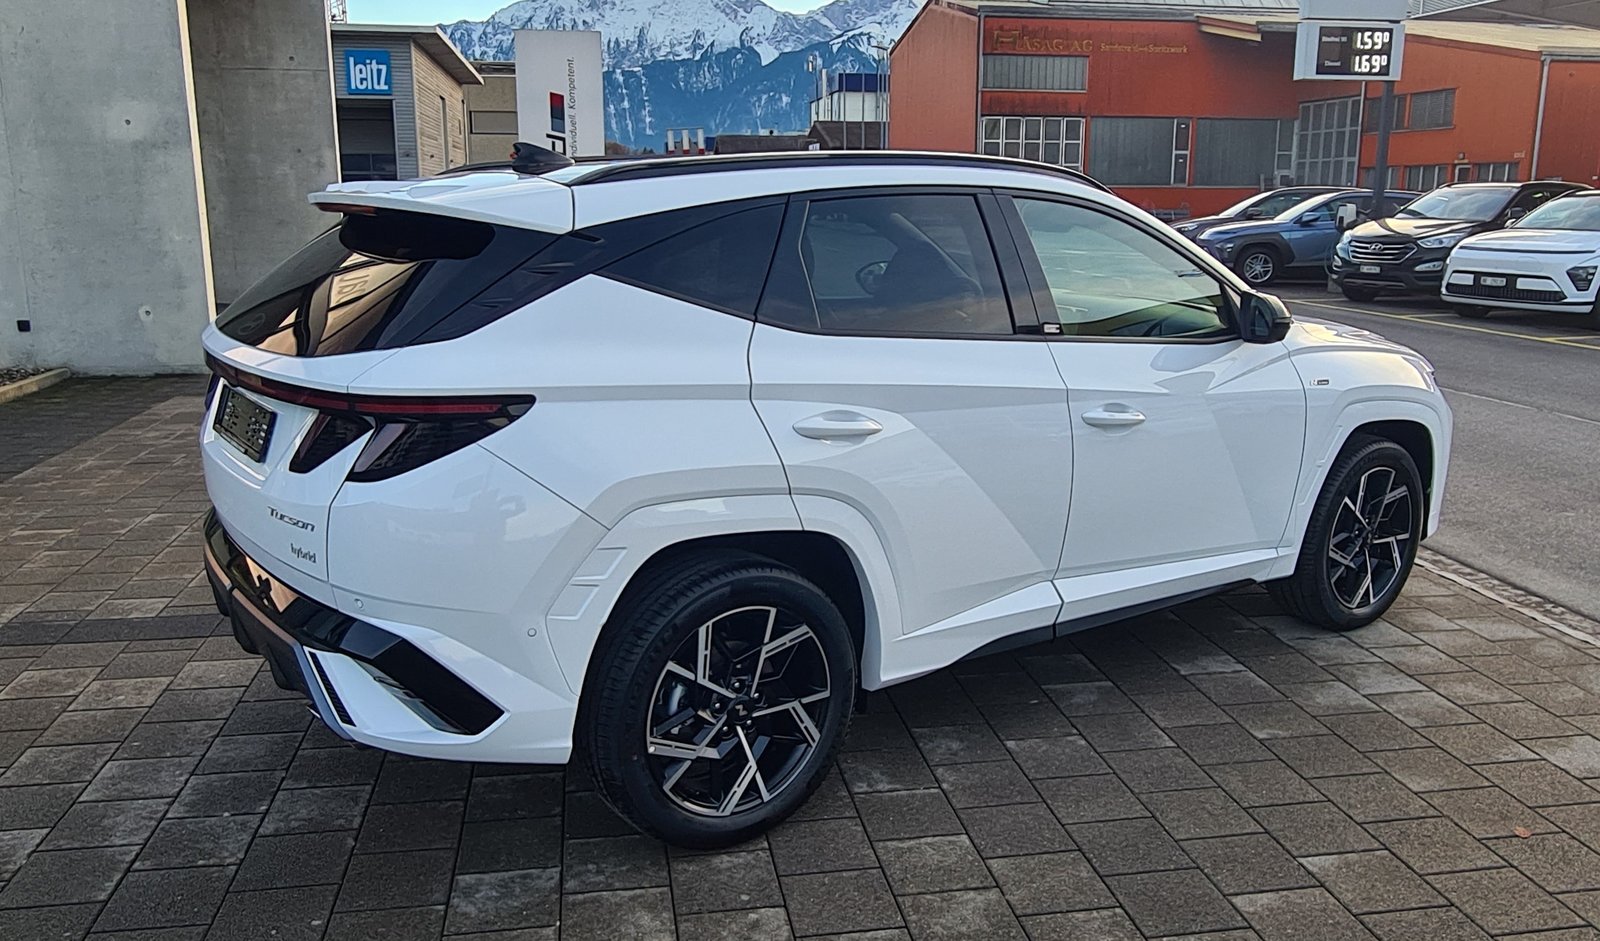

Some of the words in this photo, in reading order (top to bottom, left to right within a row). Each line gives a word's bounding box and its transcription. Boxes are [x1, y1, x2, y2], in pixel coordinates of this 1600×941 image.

[1070, 39, 1093, 52] AG
[349, 56, 388, 90] leitz
[566, 57, 577, 110] Kompetent.
[290, 542, 317, 564] hybrid
